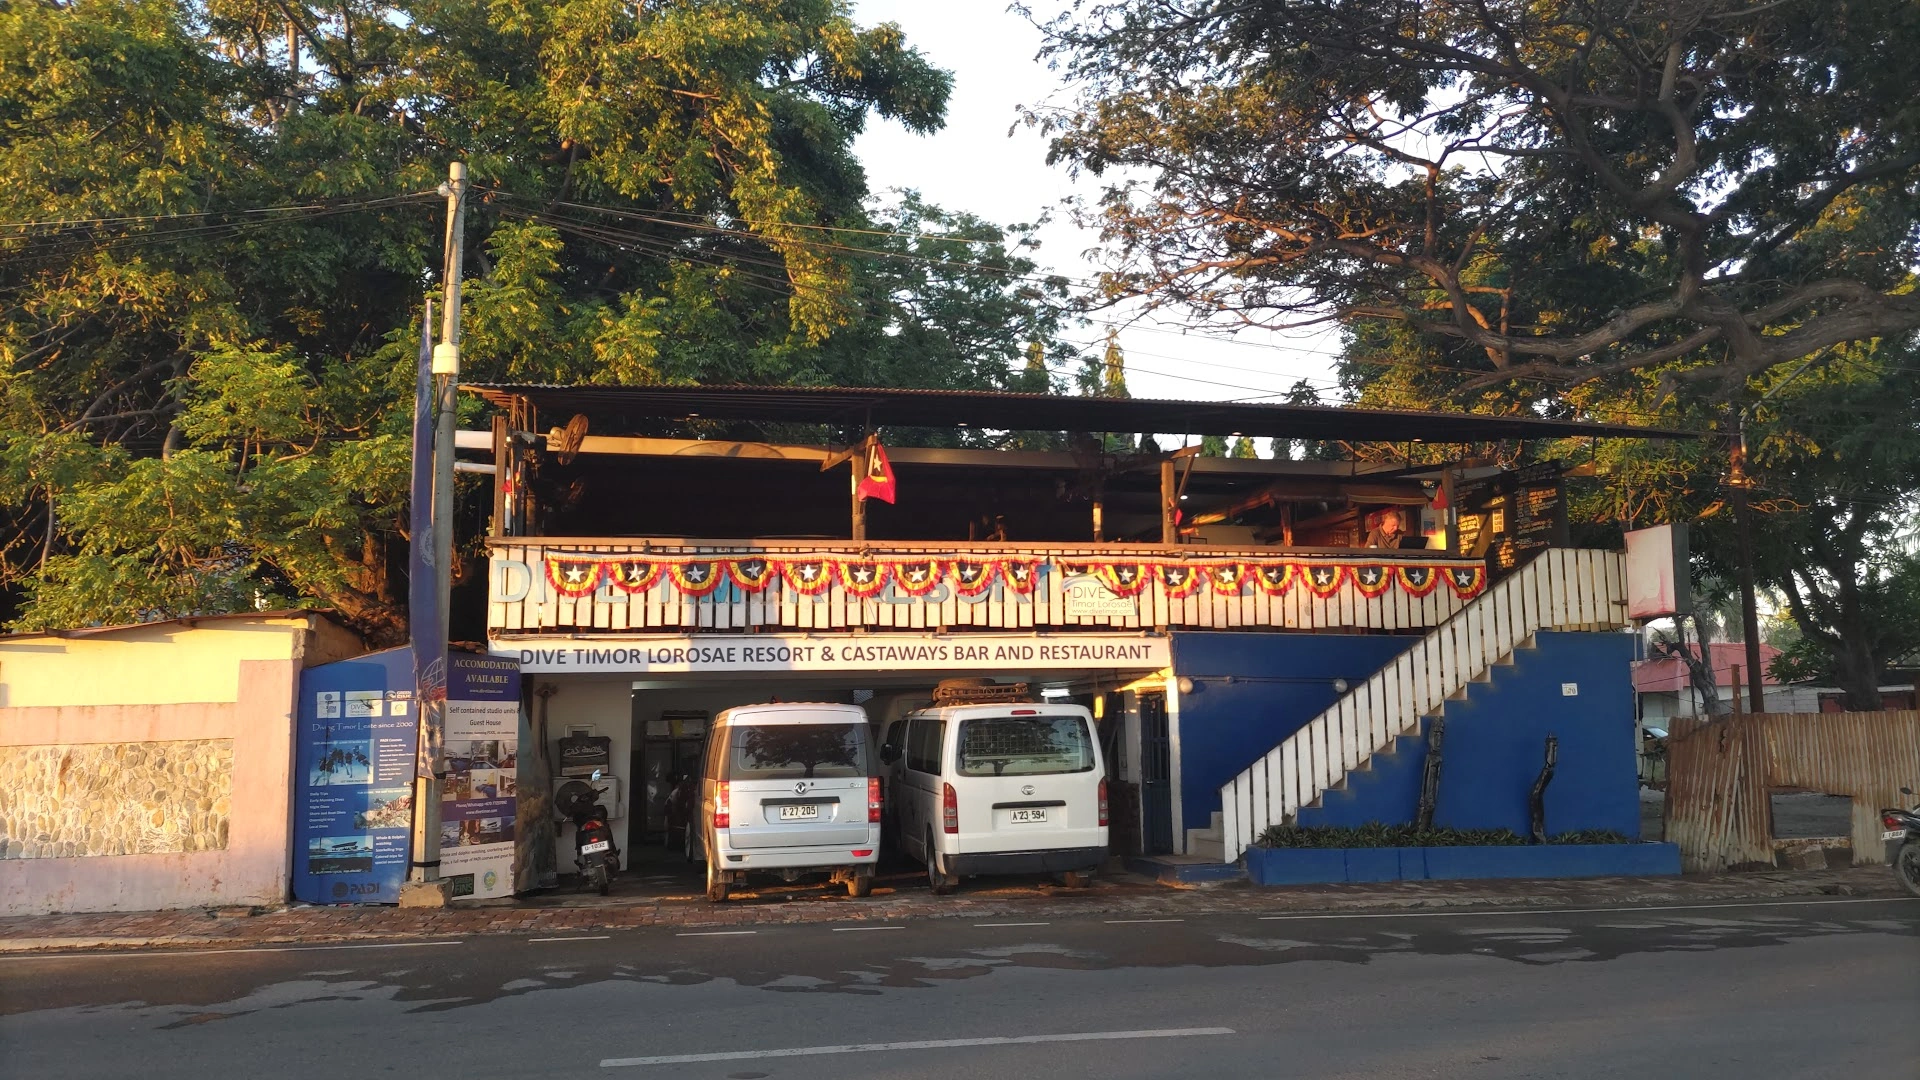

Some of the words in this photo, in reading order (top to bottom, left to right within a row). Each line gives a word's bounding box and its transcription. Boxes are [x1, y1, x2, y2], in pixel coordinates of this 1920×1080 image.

[1073, 586, 1107, 599] DIVE
[1072, 599, 1096, 608] Timor
[520, 648, 567, 665] DIVE
[573, 648, 641, 665] TIMOR
[647, 647, 736, 664] LOROSAE
[743, 646, 815, 663] RESORT
[821, 645, 835, 662] &
[841, 645, 948, 662] CASTAWAYS
[954, 645, 989, 661] BAR
[995, 645, 1034, 661] AND
[1040, 645, 1152, 660] RESTAURANT
[454, 659, 520, 671] ACCOMODATION
[465, 674, 509, 684] AVAILABLE
[312, 723, 335, 733] Diving
[335, 722, 357, 730] Timor
[789, 807, 799, 816] 27
[801, 806, 816, 816] 205
[1031, 809, 1045, 819] 594
[350, 882, 380, 895] PADI
